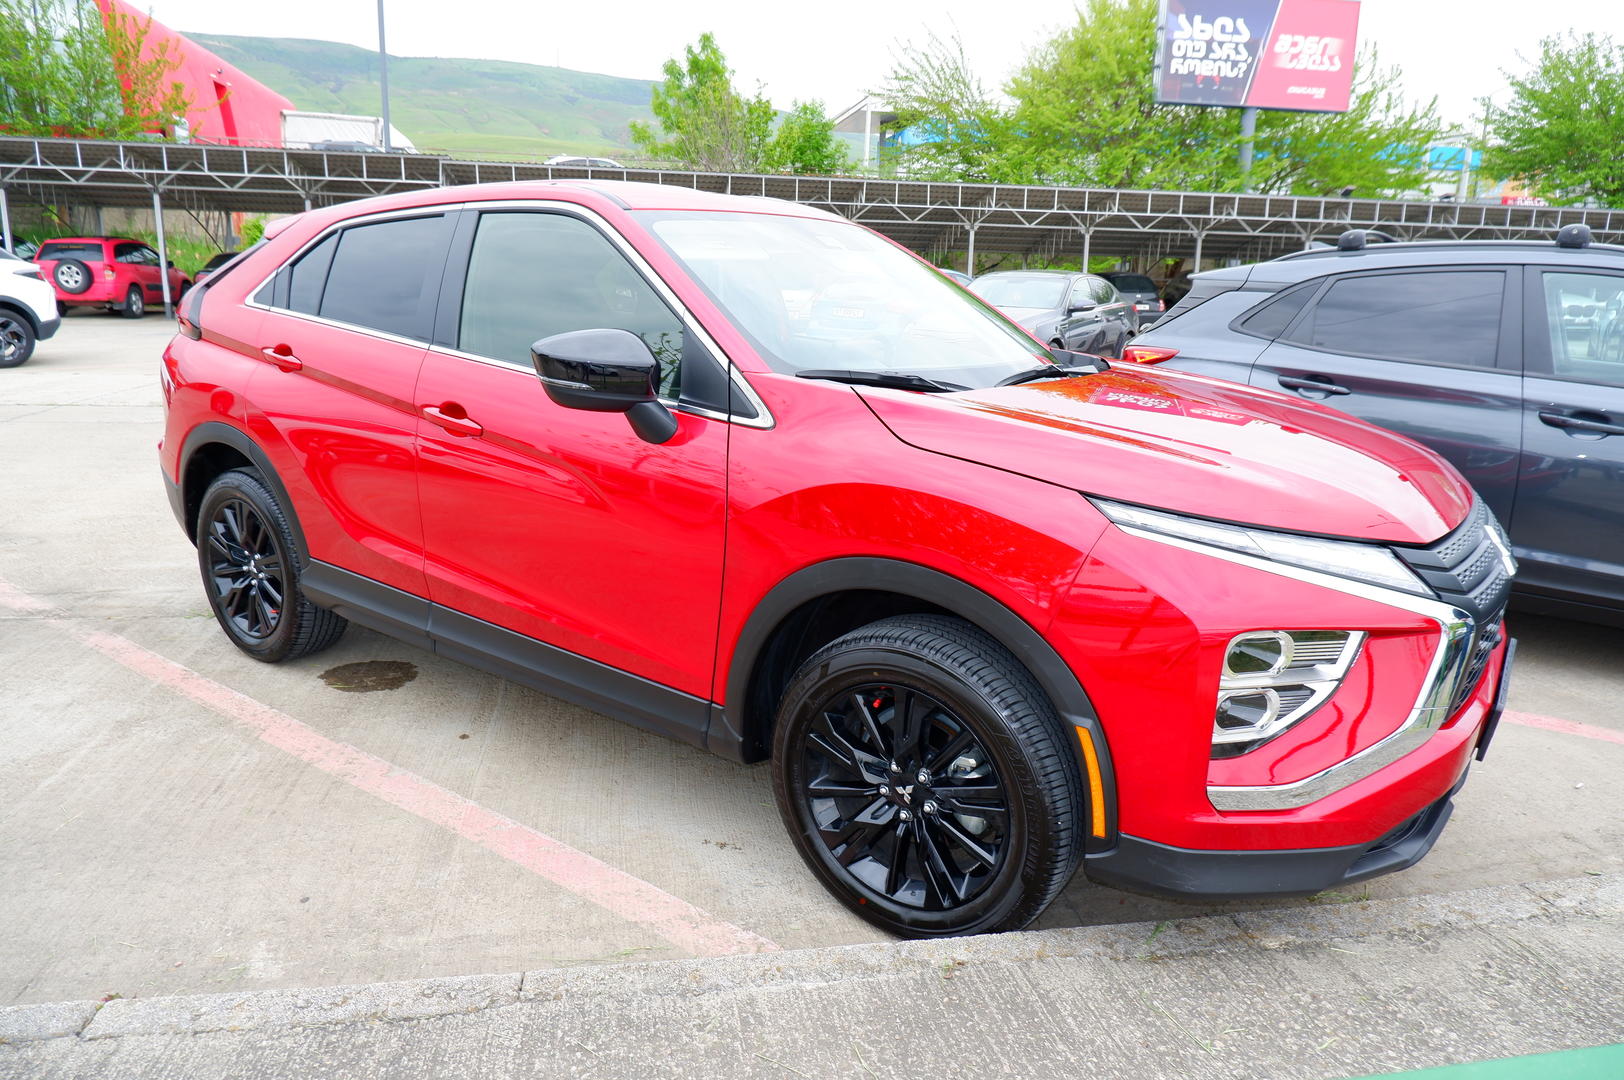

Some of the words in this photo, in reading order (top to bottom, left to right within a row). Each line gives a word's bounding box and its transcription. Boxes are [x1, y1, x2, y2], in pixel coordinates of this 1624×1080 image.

[1173, 14, 1251, 43] ახლა
[1172, 39, 1207, 58] თუ
[1208, 41, 1253, 64] არა,
[1170, 58, 1248, 78] როდის?
